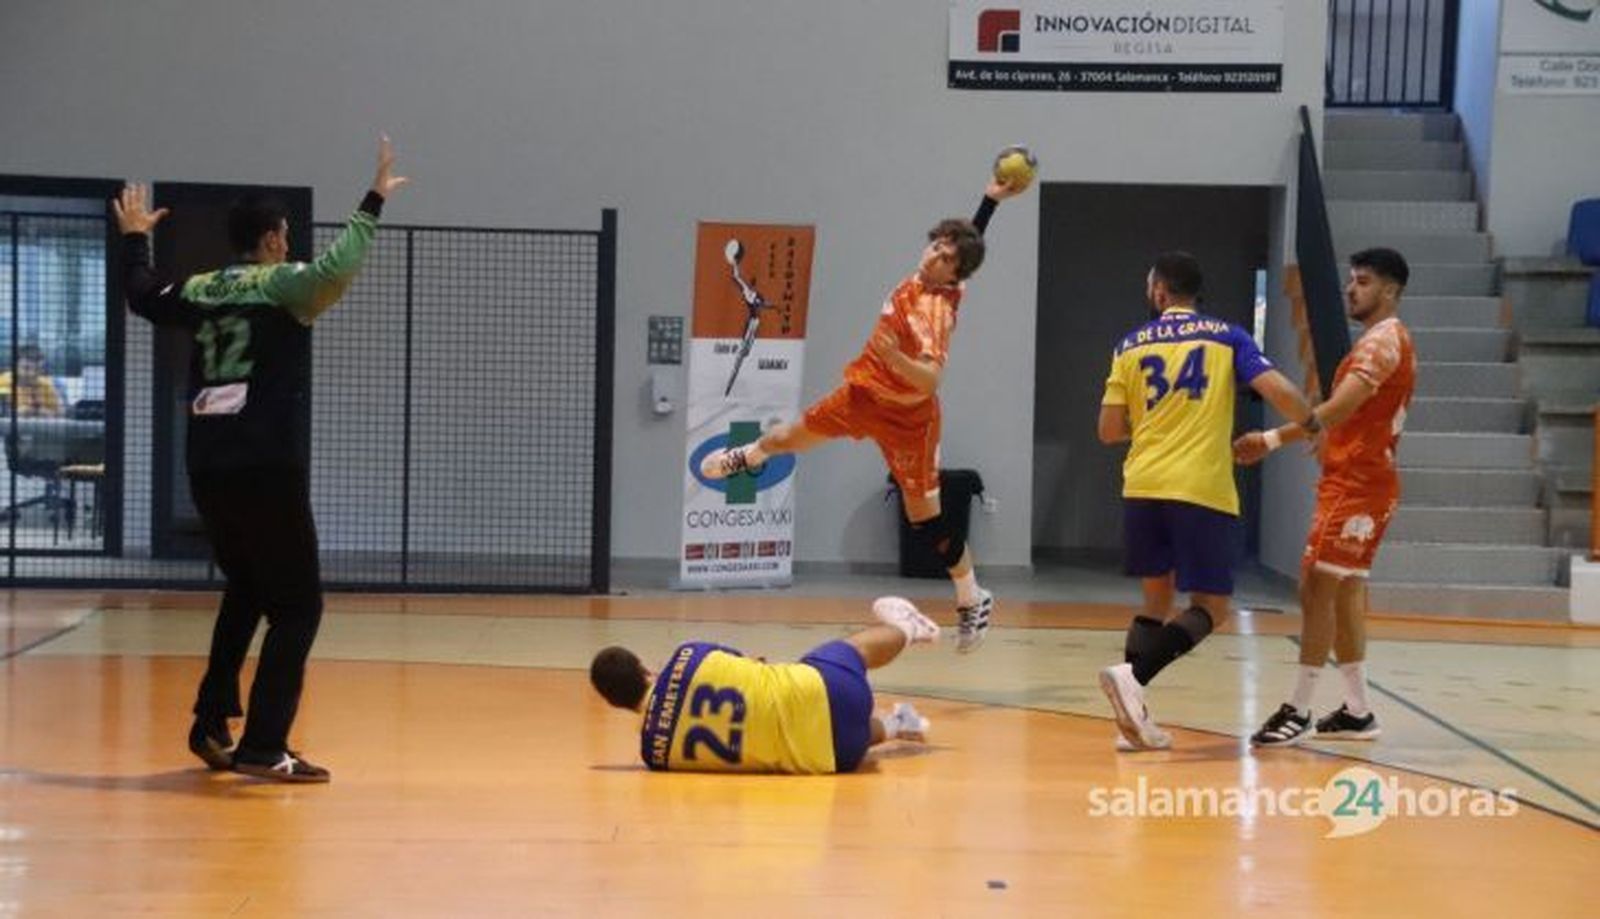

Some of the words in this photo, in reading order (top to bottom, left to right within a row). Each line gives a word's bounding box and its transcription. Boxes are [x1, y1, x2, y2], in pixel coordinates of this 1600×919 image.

[1115, 71, 1168, 83] Salamanca
[195, 315, 254, 382] 12
[1137, 326, 1154, 343] DE
[1156, 325, 1175, 339] LA
[1177, 319, 1230, 336] GRANJA
[1139, 343, 1210, 412] 34
[686, 509, 766, 529] CONGESA
[682, 683, 747, 765] 23
